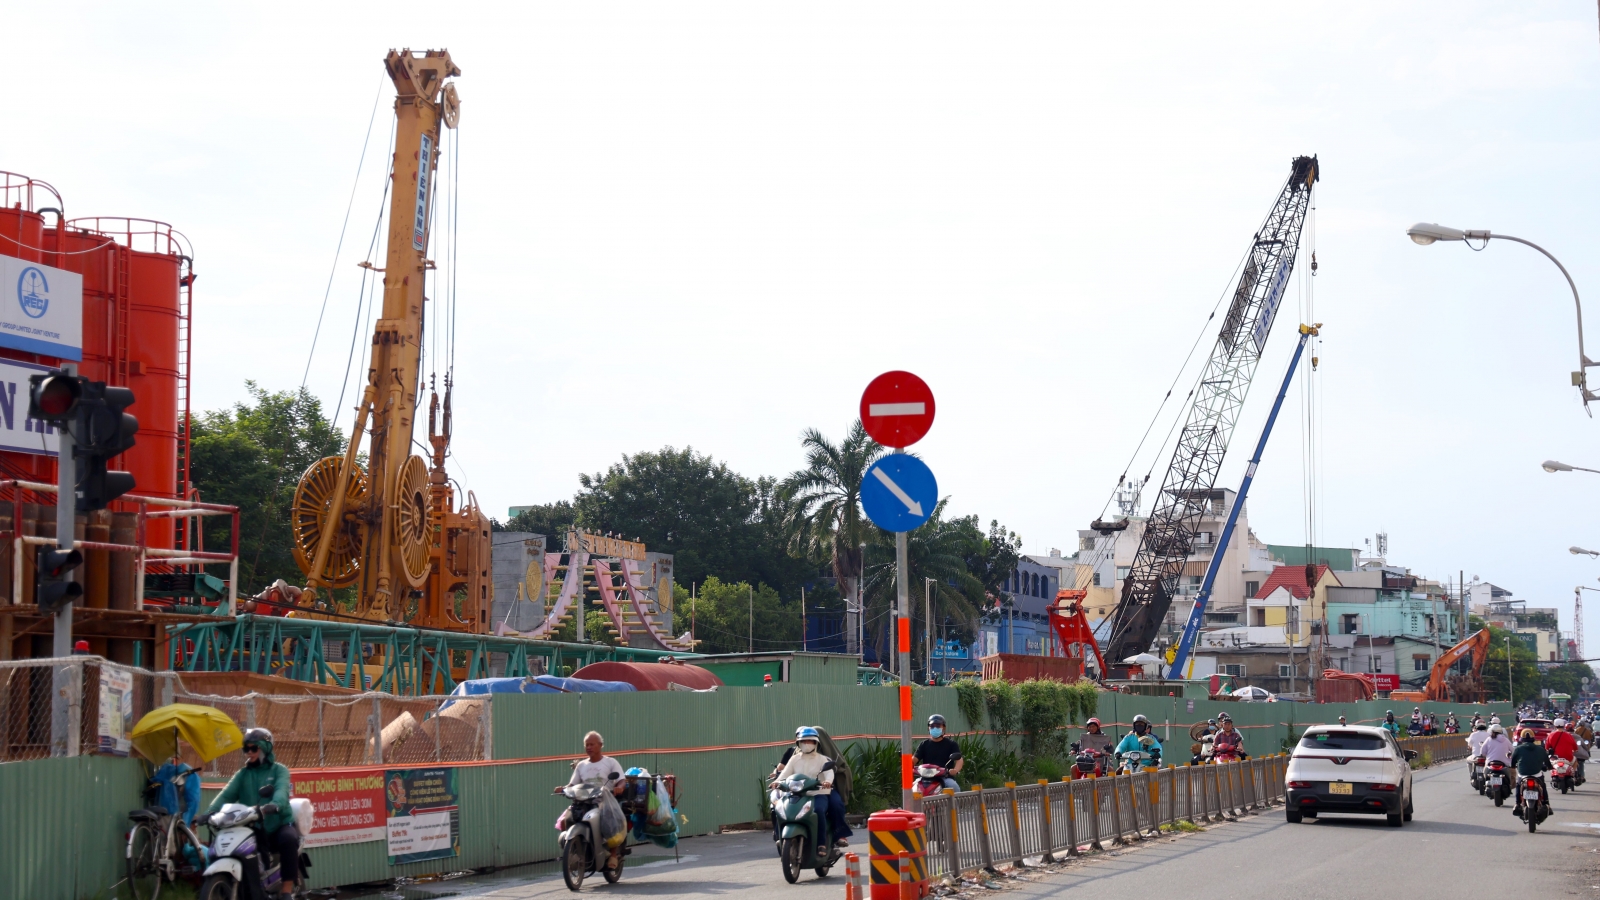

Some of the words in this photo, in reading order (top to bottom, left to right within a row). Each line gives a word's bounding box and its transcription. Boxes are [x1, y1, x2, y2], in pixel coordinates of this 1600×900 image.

[295, 781, 314, 797] HOẠT
[316, 777, 336, 796] ĐỘNG
[337, 776, 354, 791] BÌNH
[317, 801, 331, 813] MUA
